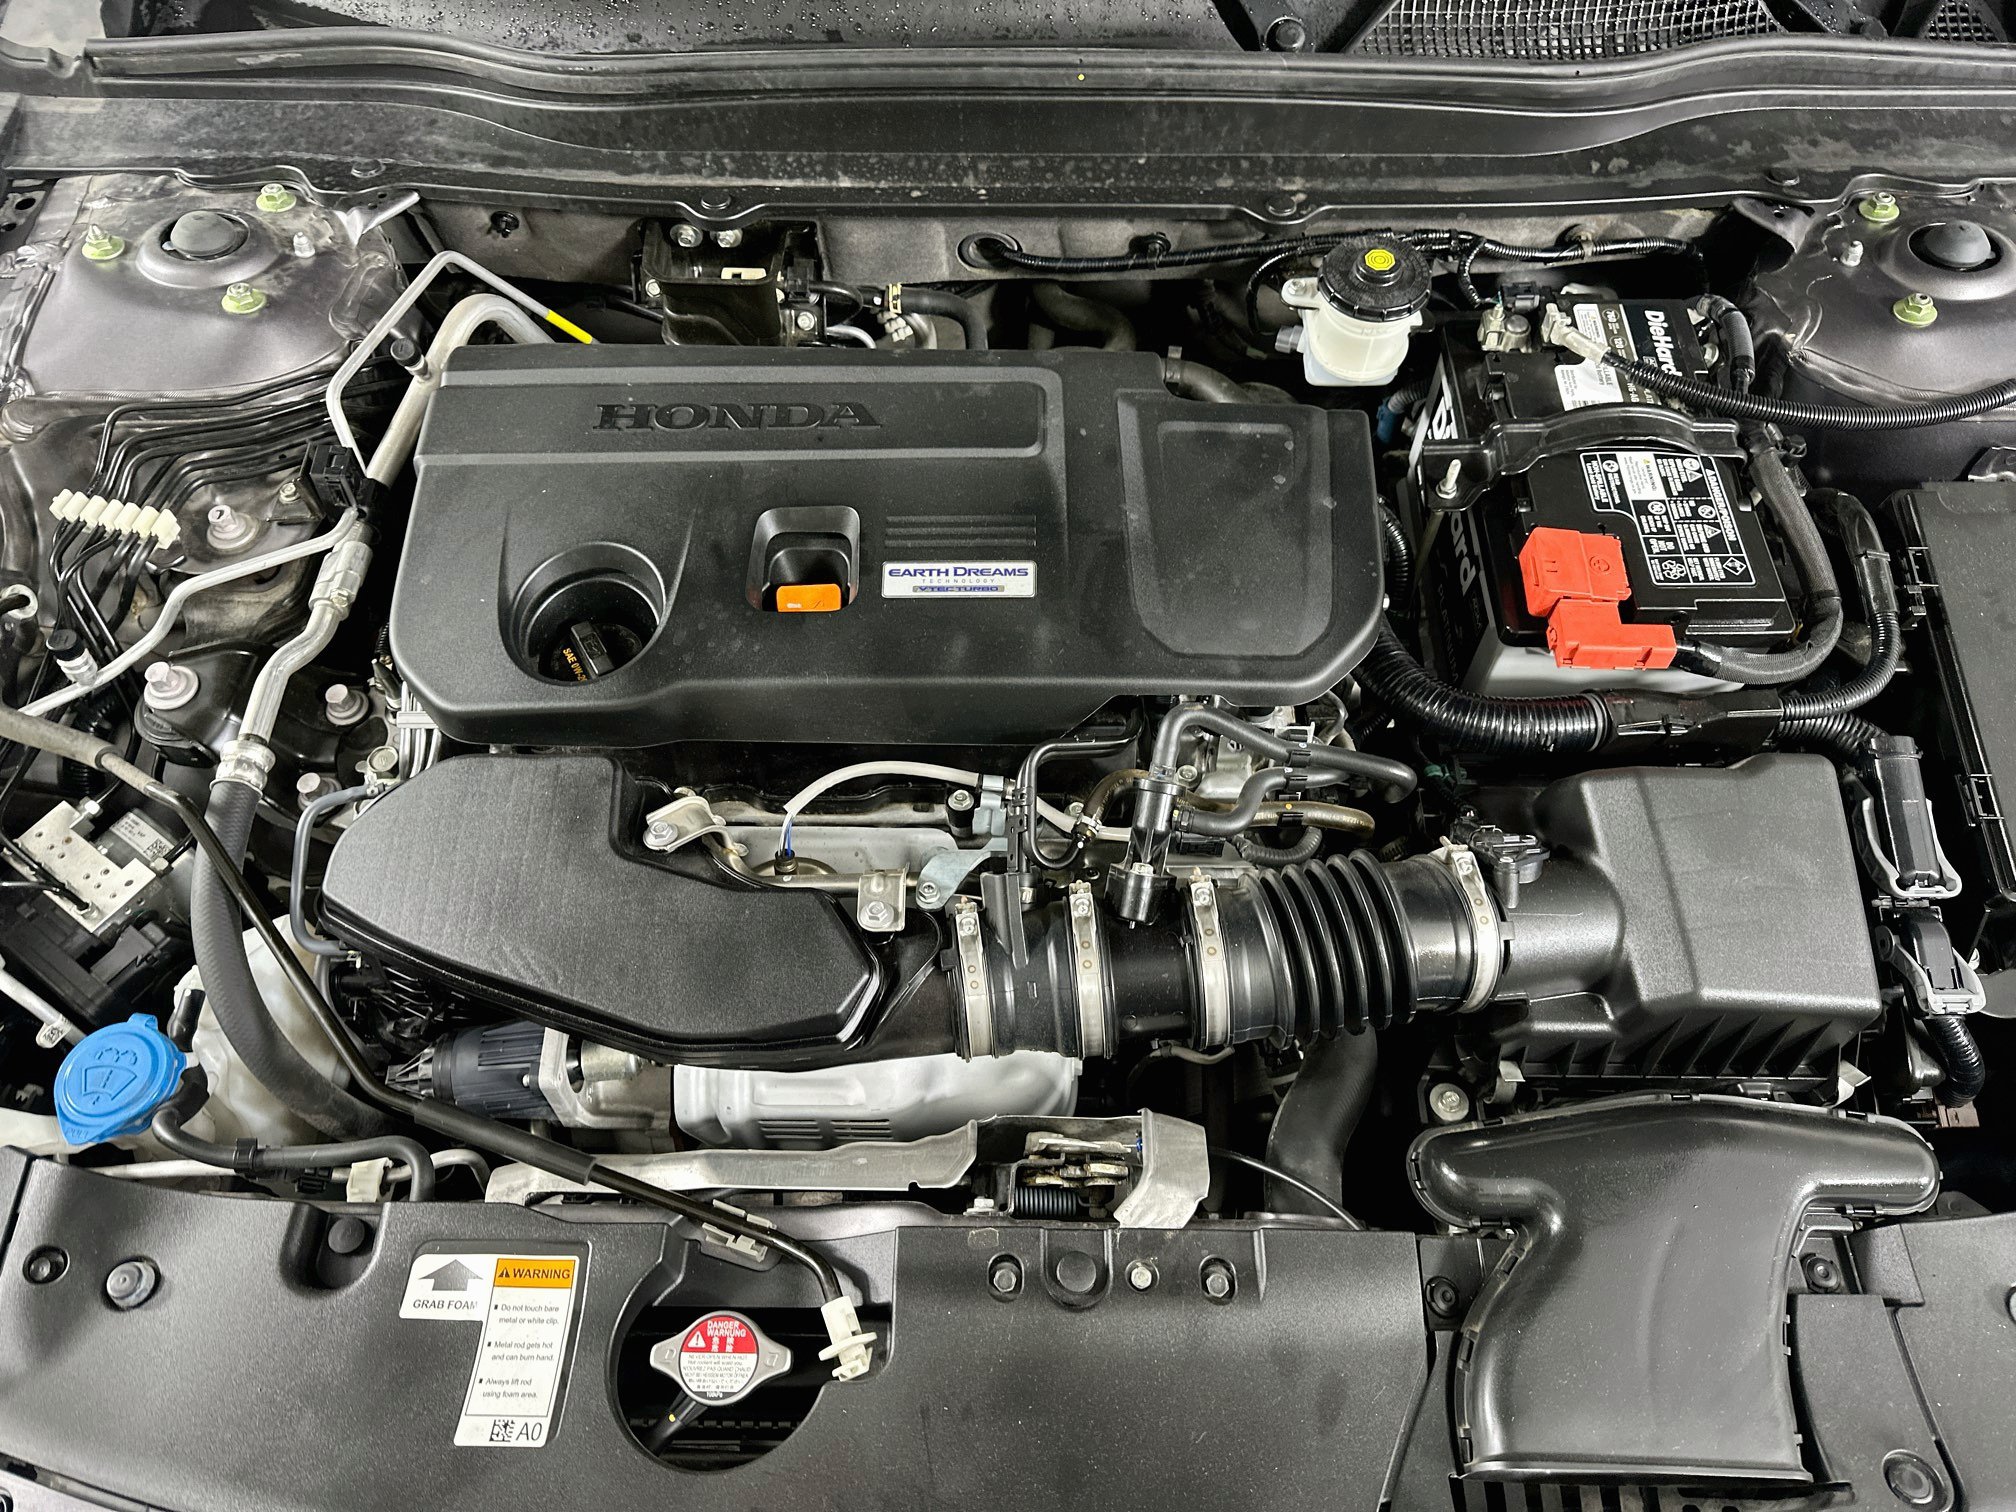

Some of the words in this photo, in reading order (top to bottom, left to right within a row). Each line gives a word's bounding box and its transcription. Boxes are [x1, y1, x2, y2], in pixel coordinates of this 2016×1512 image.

[1644, 310, 1683, 377] DieHard
[593, 402, 883, 431] HONDA
[888, 568, 949, 577] EARTH
[562, 647, 577, 664] SAE
[571, 663, 588, 682] 0W-2
[513, 1268, 571, 1279] WARNING
[413, 1299, 445, 1309] GRAB
[447, 1300, 478, 1310] FOAM
[501, 1304, 511, 1312] Do
[512, 1304, 523, 1312] not
[546, 1318, 559, 1326] clip.
[707, 1320, 740, 1330] DANGER
[707, 1329, 747, 1338] WARNUNG
[494, 1341, 513, 1349] Metal
[514, 1341, 525, 1349] rod
[526, 1342, 540, 1350] gets
[542, 1341, 553, 1349] hot
[485, 1378, 509, 1386] Always
[510, 1378, 519, 1386] lift
[520, 1378, 532, 1386] rod
[483, 1391, 501, 1399] using
